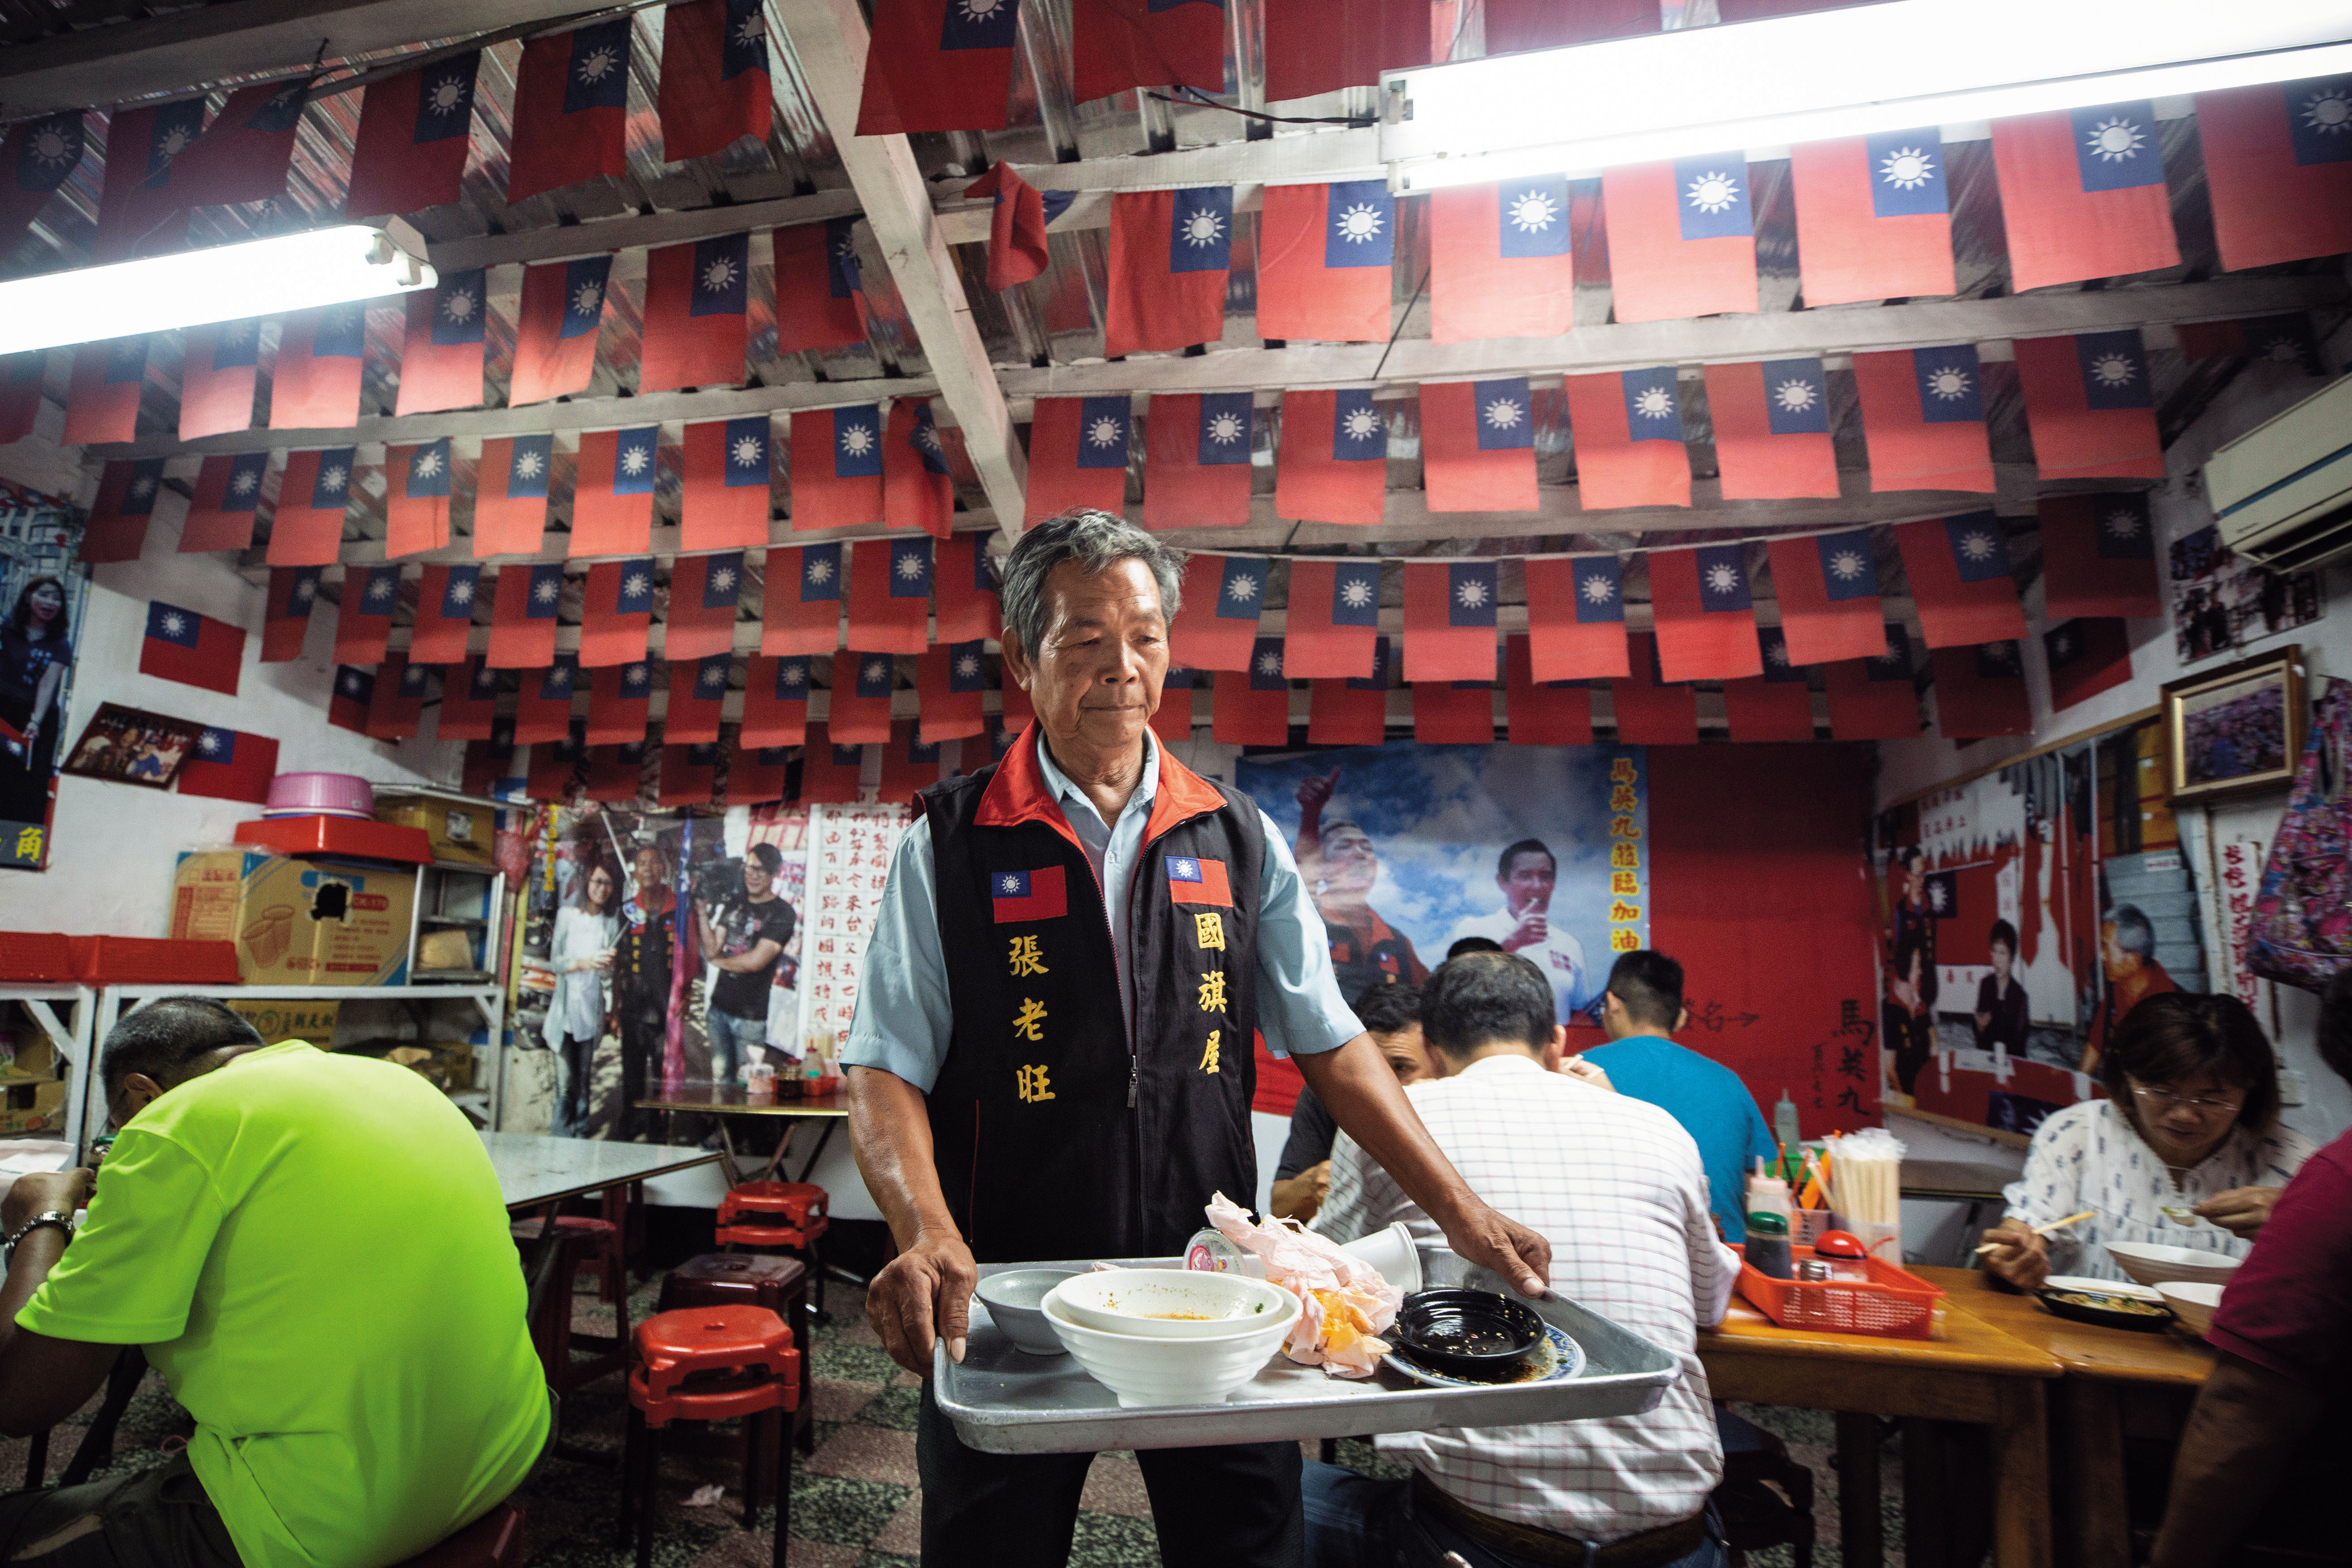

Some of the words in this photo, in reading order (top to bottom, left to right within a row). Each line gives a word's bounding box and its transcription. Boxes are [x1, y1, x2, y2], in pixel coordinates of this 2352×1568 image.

[1009, 935, 1056, 1103] 張老旺
[1194, 913, 1227, 1074] 國旗屋
[1833, 999, 1875, 1116] 馬英九
